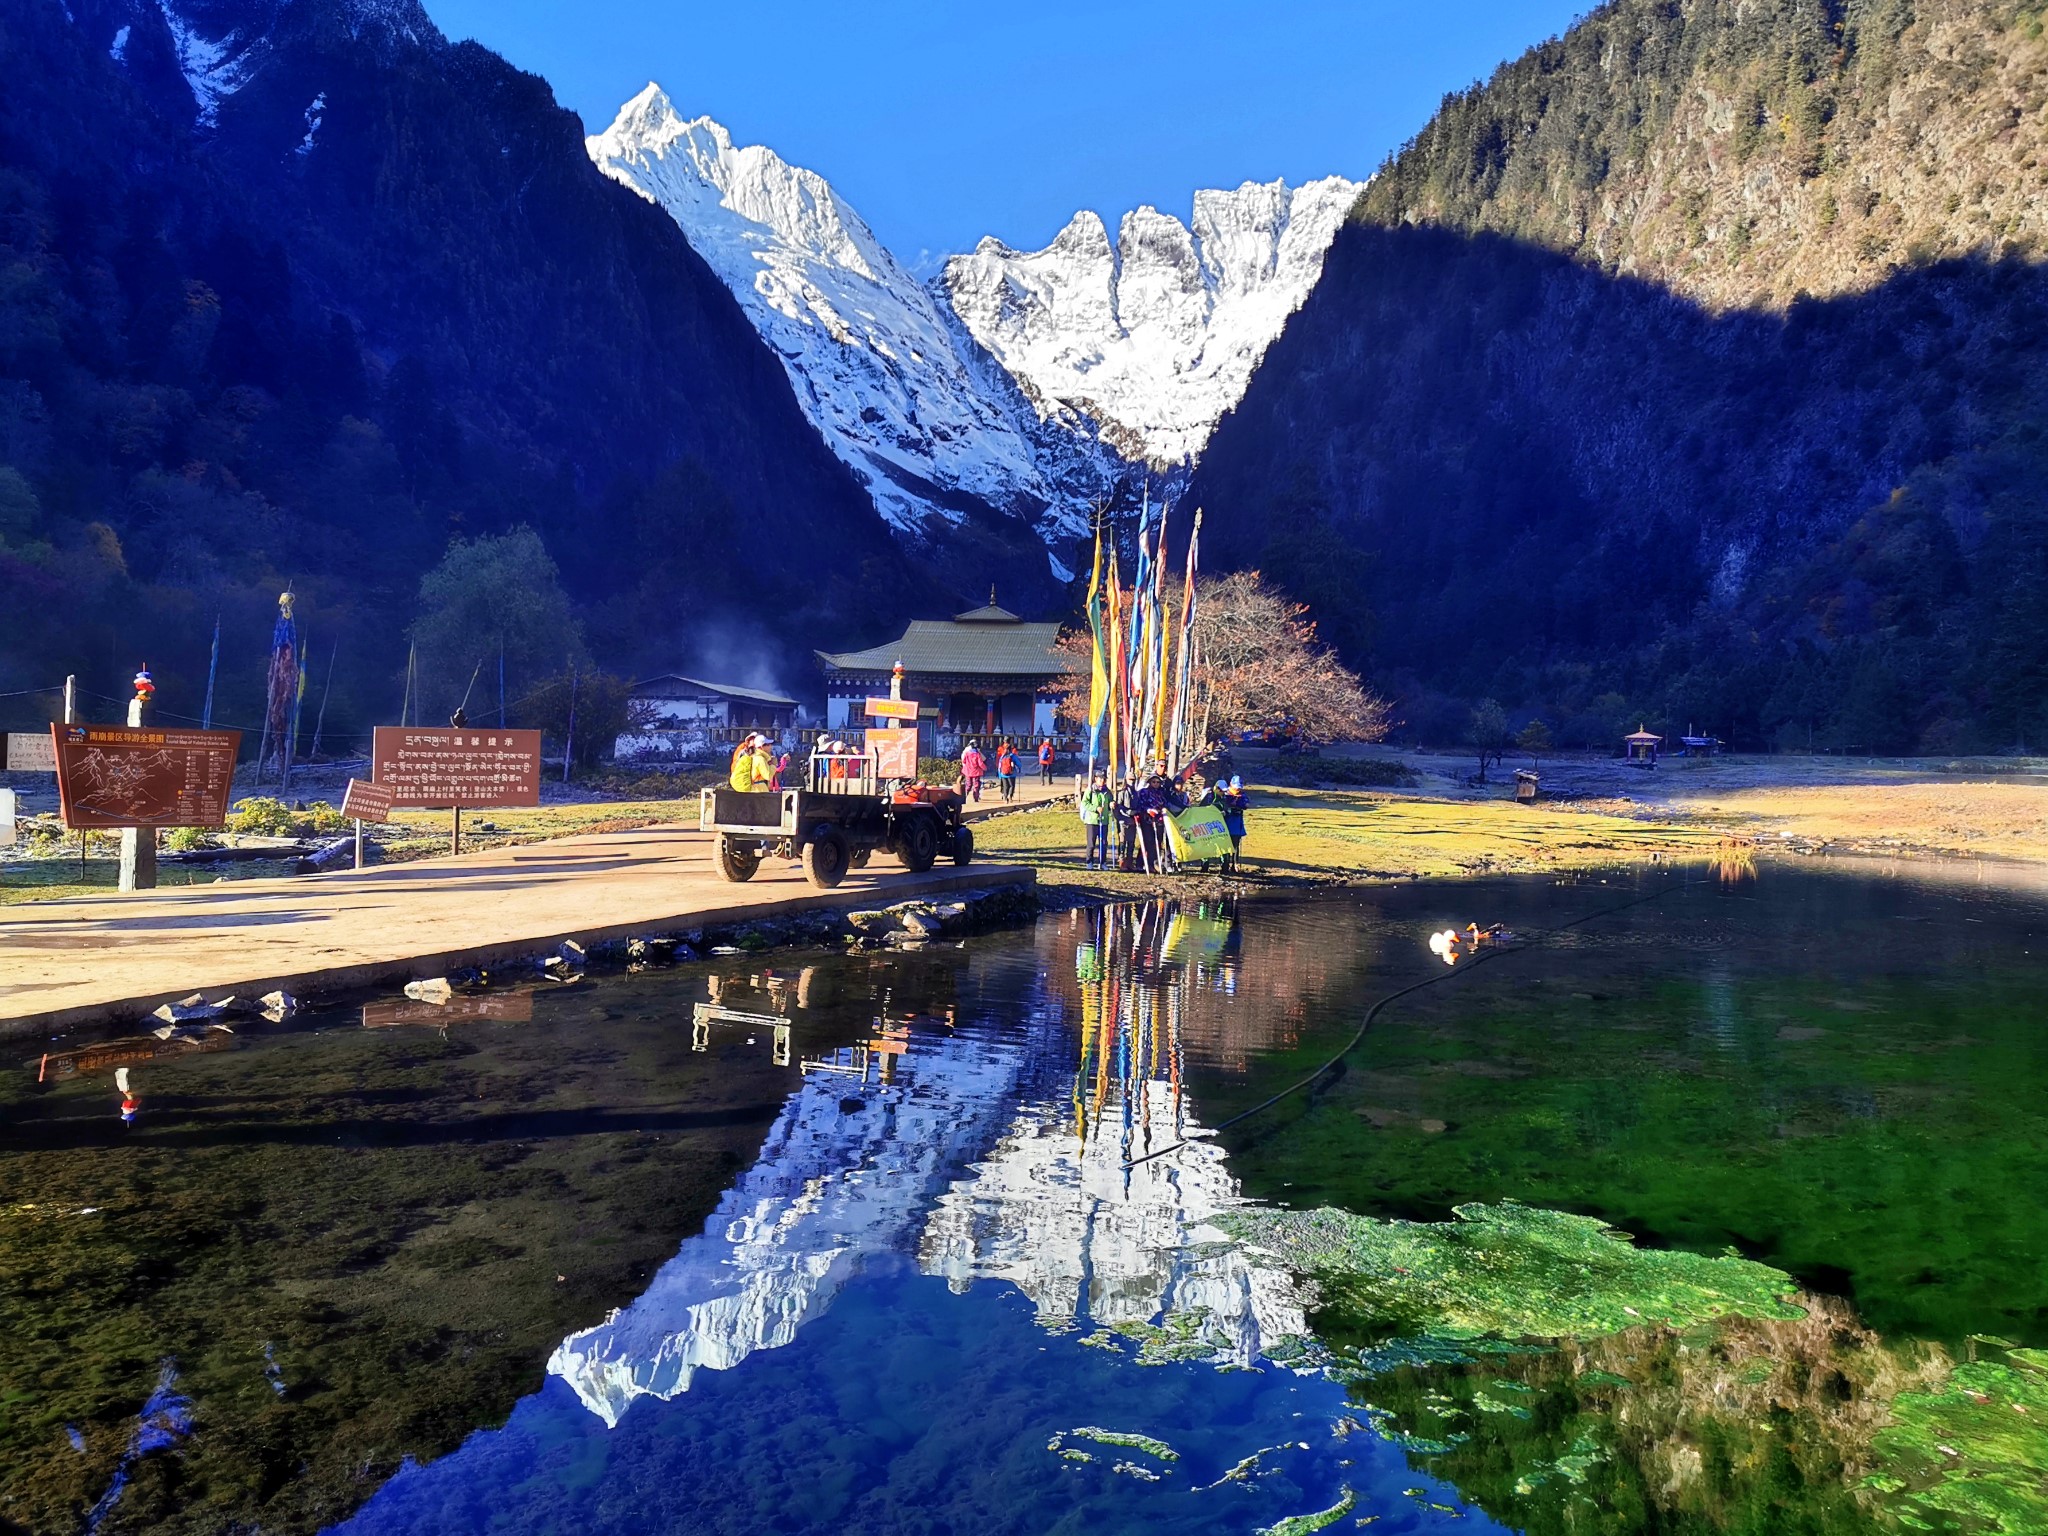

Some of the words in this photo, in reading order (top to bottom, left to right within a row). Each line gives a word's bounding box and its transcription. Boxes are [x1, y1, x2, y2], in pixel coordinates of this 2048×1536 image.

[89, 731, 164, 743] 雨崩景区导游全景图
